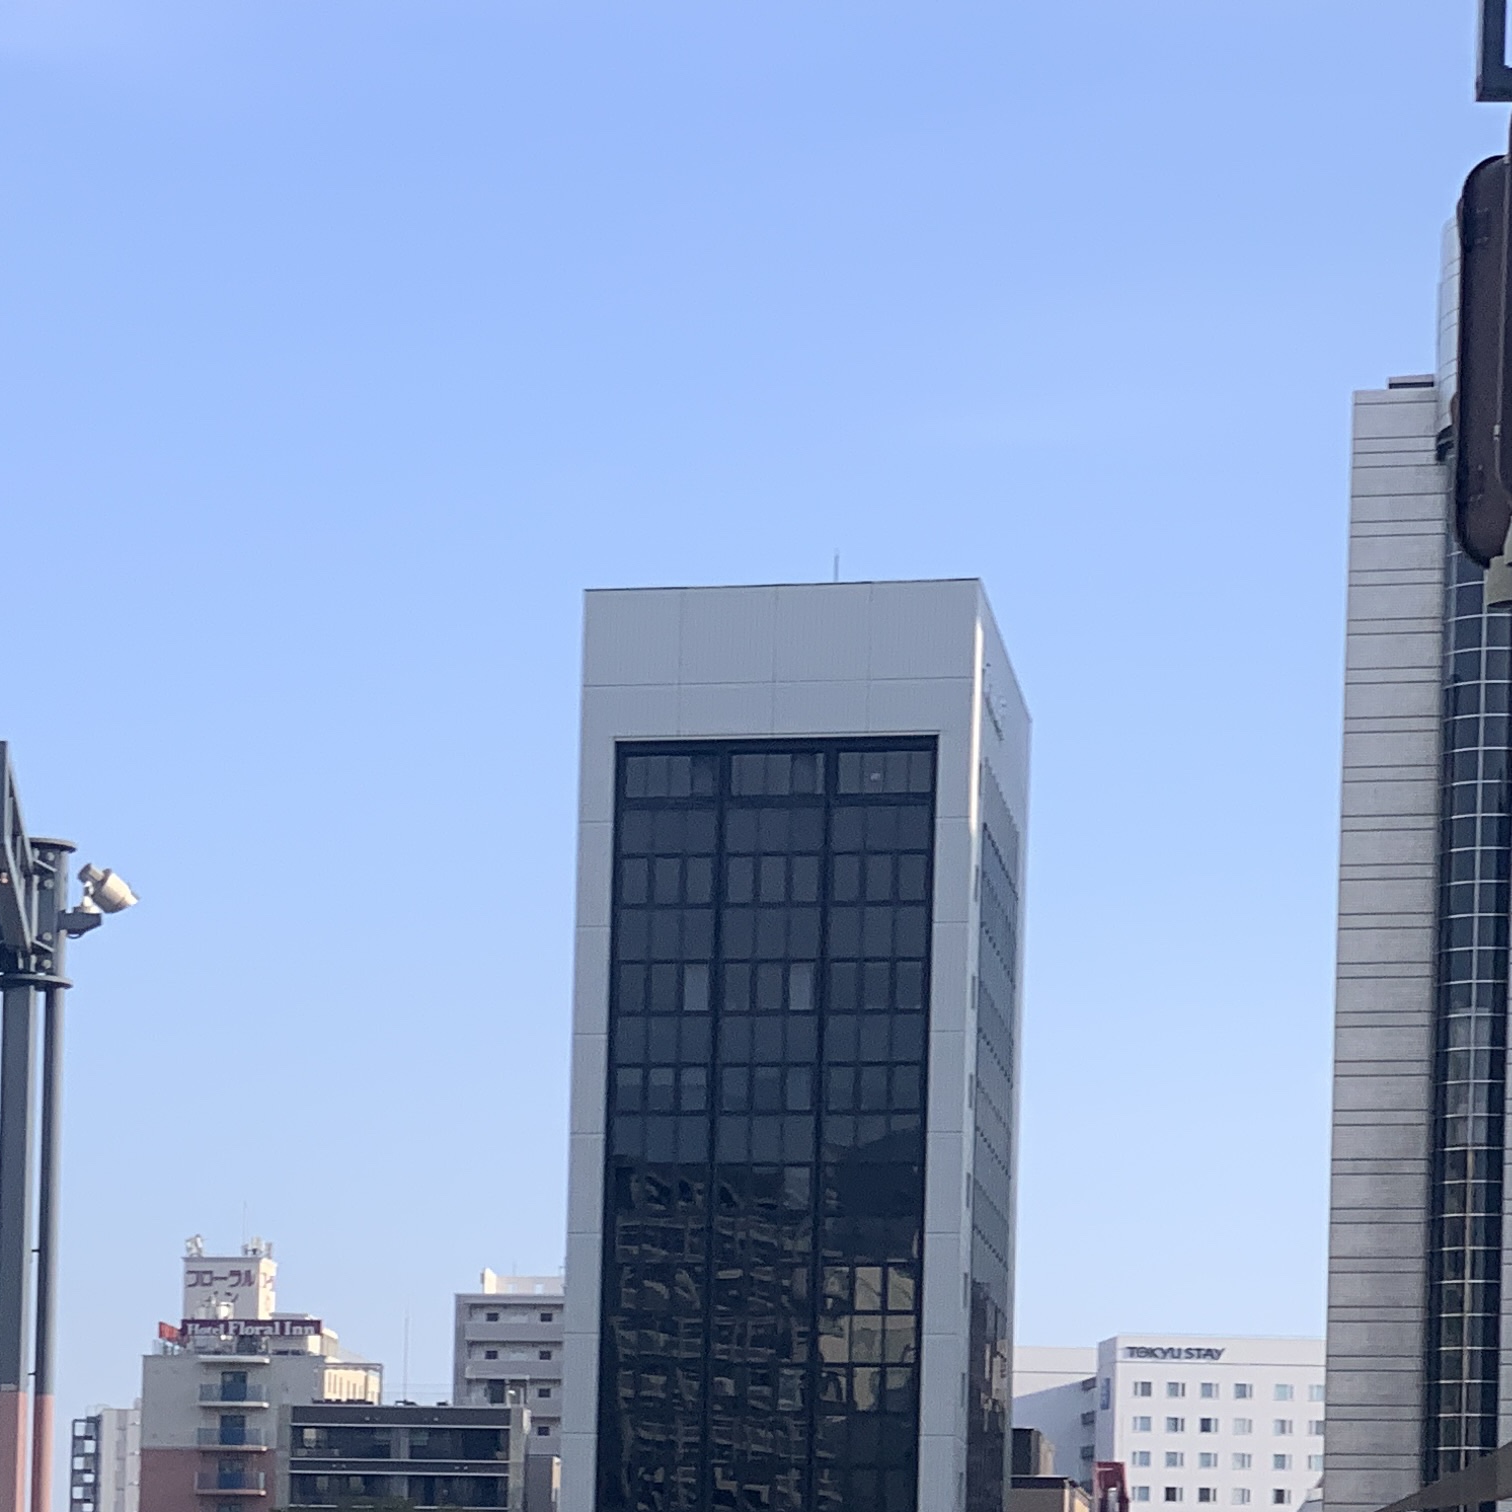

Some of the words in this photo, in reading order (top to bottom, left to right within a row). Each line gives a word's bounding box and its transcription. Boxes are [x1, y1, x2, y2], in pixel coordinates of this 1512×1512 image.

[187, 1269, 255, 1287] フローラル
[187, 1323, 224, 1336] Hotel
[228, 1320, 280, 1336] Floral
[284, 1321, 316, 1335] Inn
[1125, 1346, 1182, 1360] TOKYU
[1184, 1347, 1227, 1361] STAY
